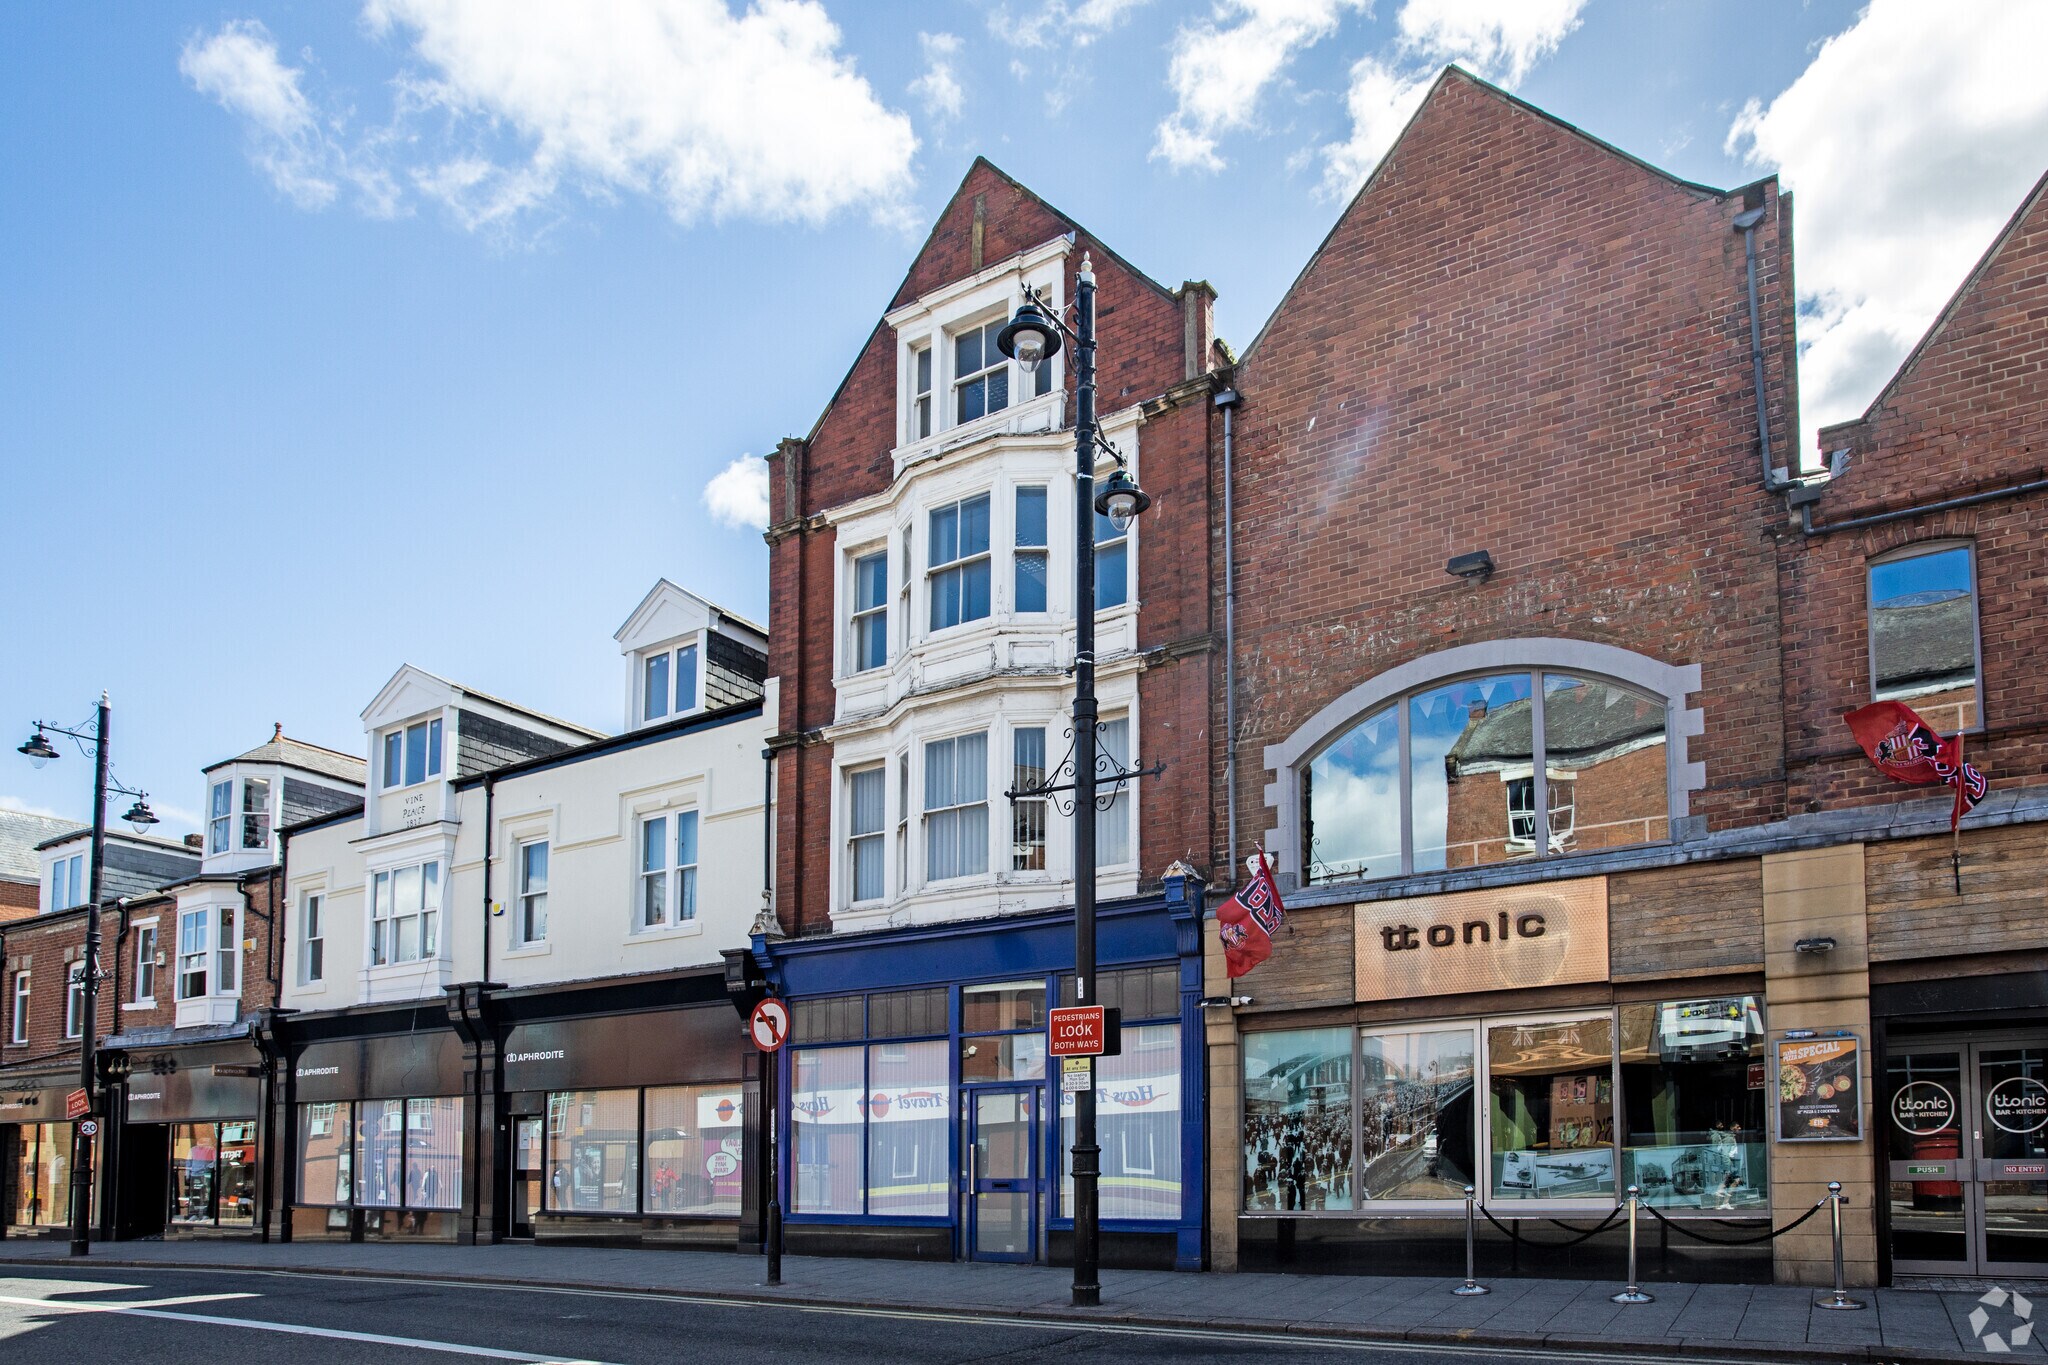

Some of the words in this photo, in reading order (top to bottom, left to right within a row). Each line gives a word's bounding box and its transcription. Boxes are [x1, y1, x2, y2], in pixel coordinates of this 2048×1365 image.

[405, 794, 423, 804] VINE
[402, 806, 425, 818] PLACE
[1053, 1012, 1100, 1022] PEDESTRIANS
[1060, 1024, 1093, 1038] LOOK
[1054, 1041, 1075, 1050] BOTH
[1077, 1040, 1099, 1048] WAYS
[1797, 1041, 1840, 1060] SPECIAL
[518, 1050, 565, 1062] APHRODITE
[304, 1067, 339, 1076] APHRODITE
[134, 1092, 161, 1100] APHRODITE
[71, 1098, 86, 1109] LOOK
[83, 1124, 97, 1132] 20
[1813, 1119, 1824, 1127] £15
